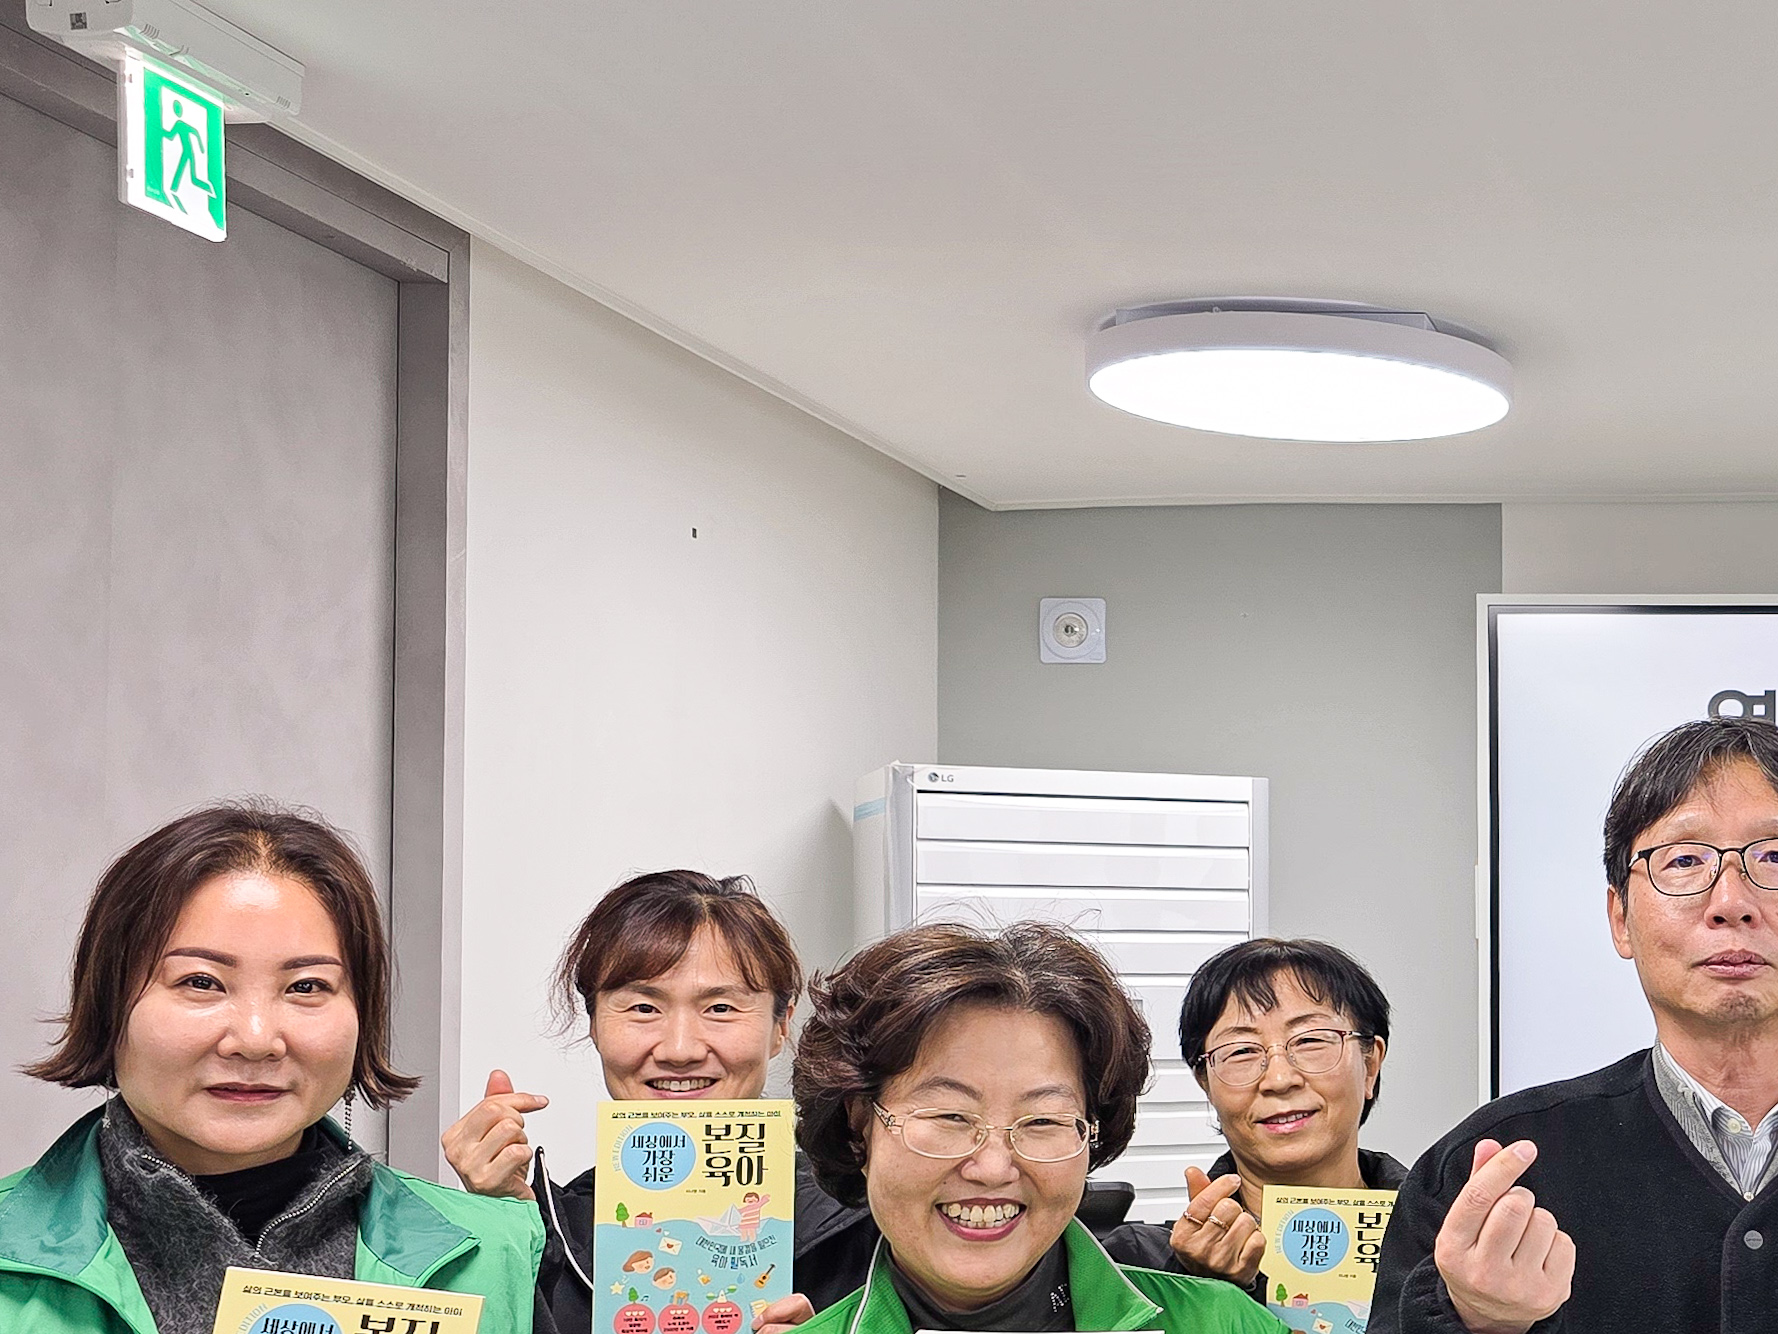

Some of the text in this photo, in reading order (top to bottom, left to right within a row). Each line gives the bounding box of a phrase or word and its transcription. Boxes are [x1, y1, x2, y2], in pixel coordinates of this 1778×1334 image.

[941, 774, 954, 783] LG
[631, 1135, 686, 1148] 세상에서
[702, 1123, 765, 1154] 본질
[642, 1150, 675, 1166] 가장
[642, 1167, 674, 1182] 쉬운
[702, 1155, 767, 1187] 육아
[1292, 1220, 1340, 1233] 세상에서
[1355, 1212, 1392, 1241] 본
[1301, 1235, 1331, 1250] 가장
[1300, 1251, 1329, 1265] 쉬운
[1354, 1243, 1381, 1273] 육
